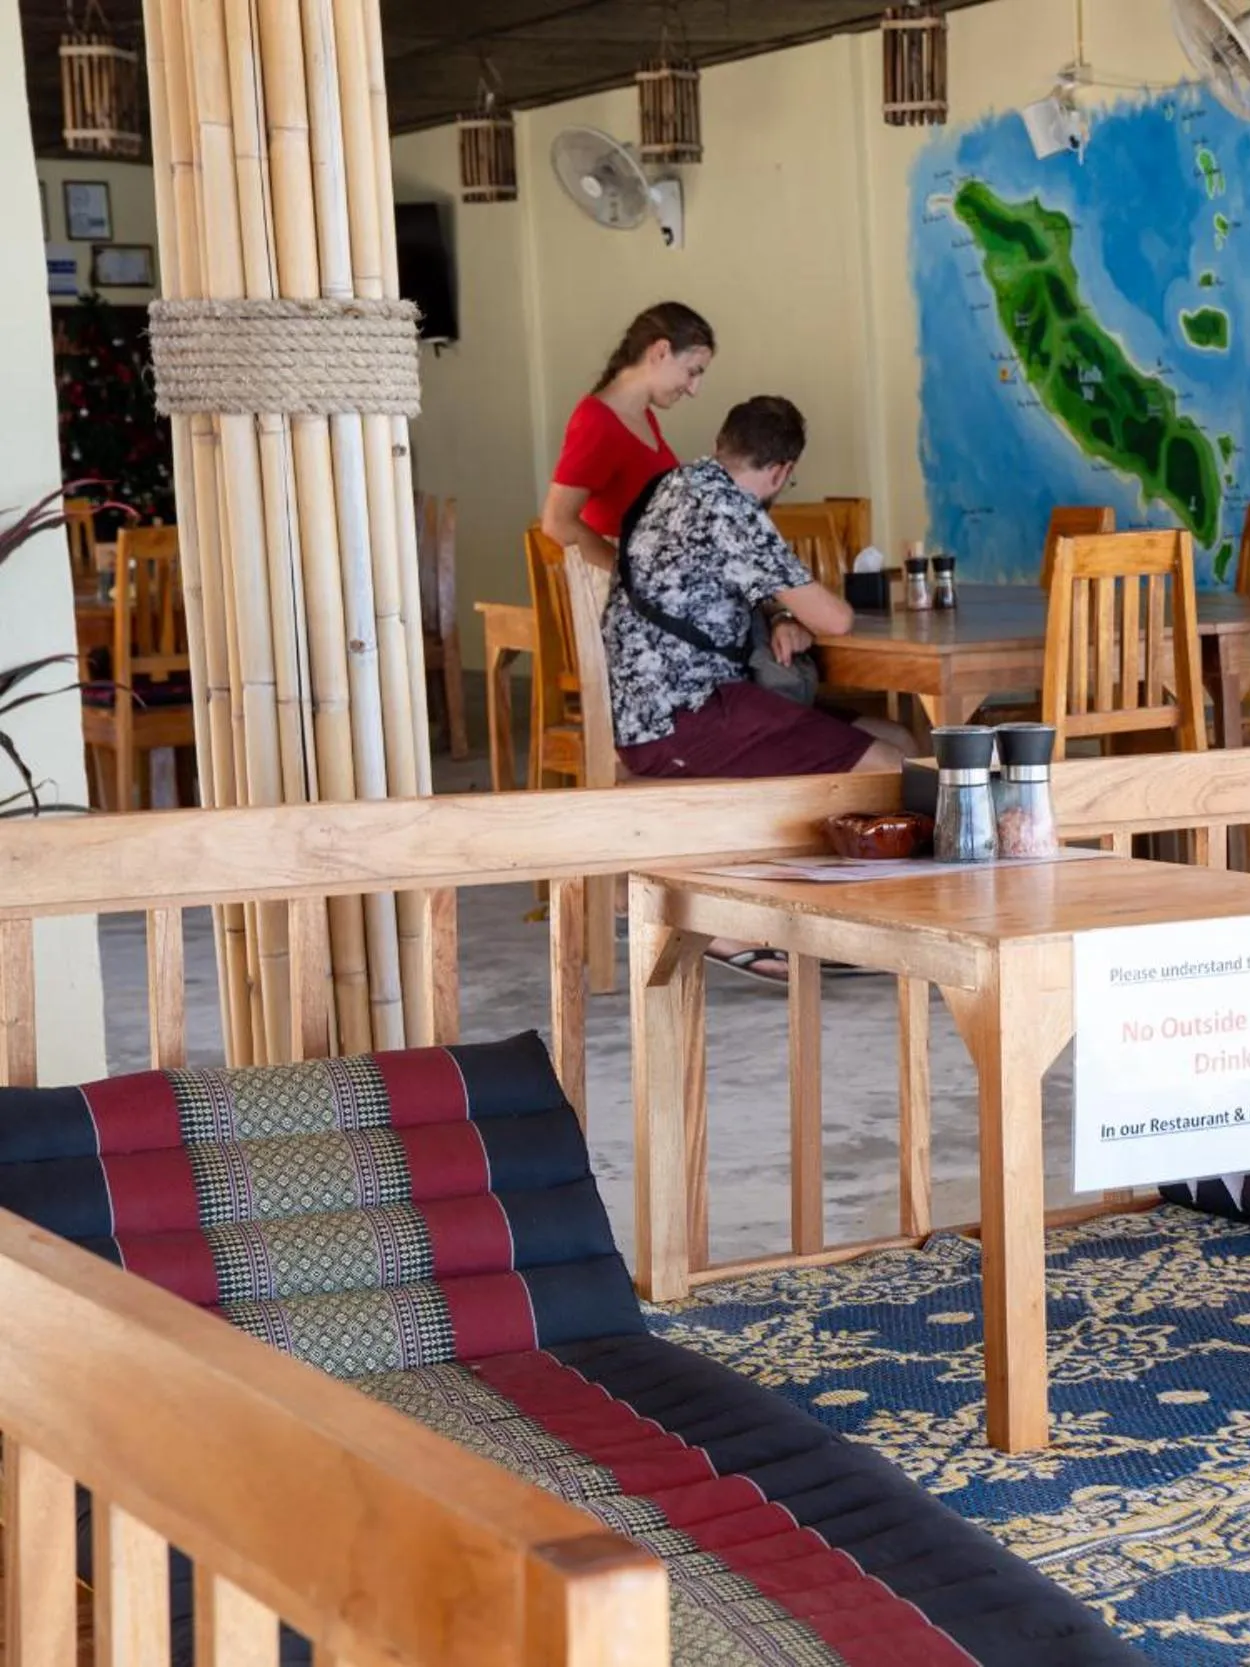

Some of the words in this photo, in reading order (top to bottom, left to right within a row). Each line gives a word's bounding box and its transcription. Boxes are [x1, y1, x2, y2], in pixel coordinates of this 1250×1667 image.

[1110, 967, 1157, 982] Please
[1161, 956, 1242, 977] understand
[1122, 1020, 1154, 1043] No
[1161, 1009, 1247, 1038] Outside
[1101, 1123, 1115, 1138] In
[1120, 1122, 1145, 1136] our
[1150, 1111, 1229, 1132] Restaurant
[1234, 1107, 1245, 1122] &
